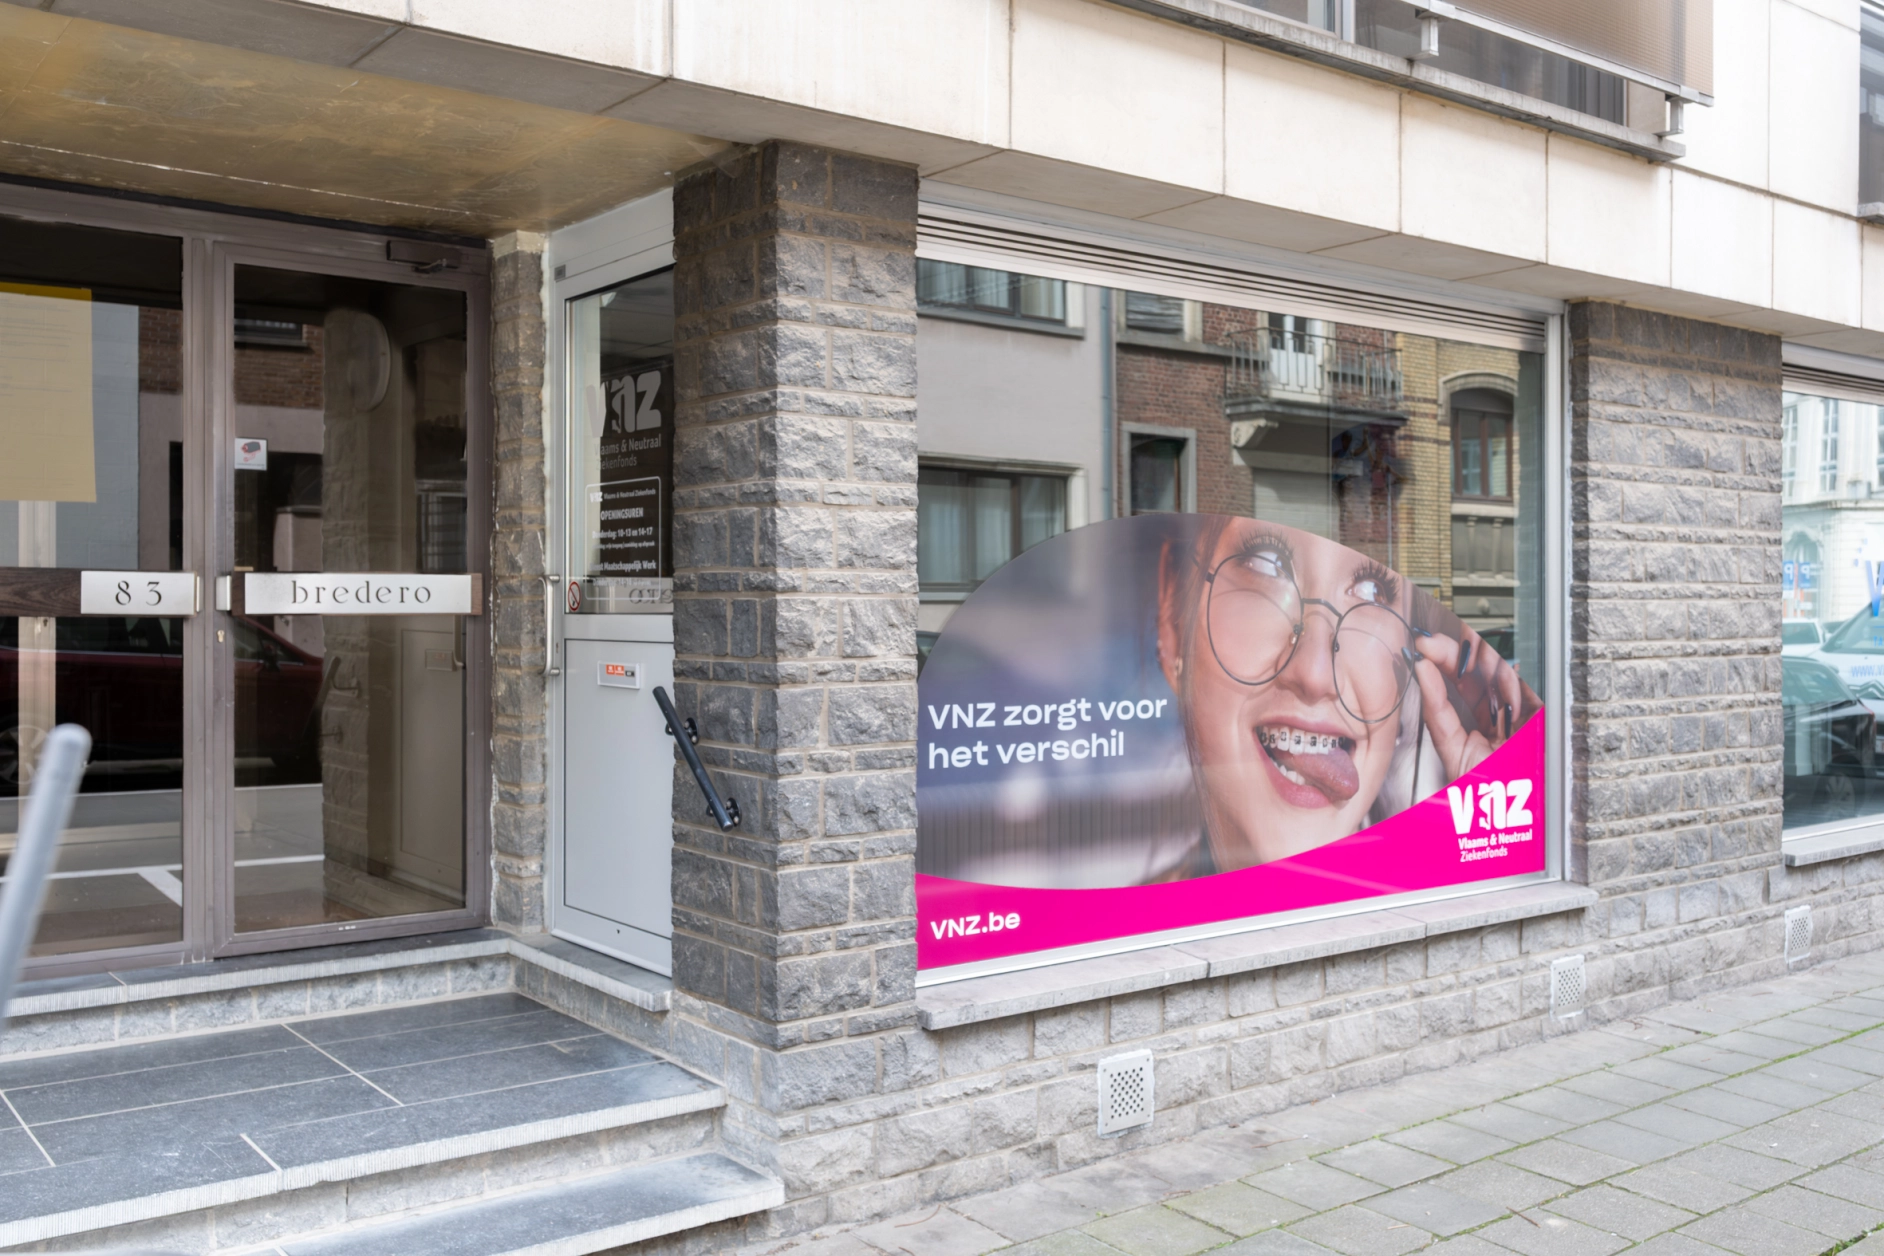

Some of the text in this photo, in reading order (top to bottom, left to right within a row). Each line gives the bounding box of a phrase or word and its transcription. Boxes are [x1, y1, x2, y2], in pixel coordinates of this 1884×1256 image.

[621, 439, 627, 452] &
[629, 433, 661, 451] Neutraal
[600, 507, 644, 521] OPENINGSUREN
[642, 559, 656, 569] Werk
[291, 580, 432, 606] bredero
[928, 699, 1168, 731] VNZ zorgt voor
[928, 730, 1125, 769] het verschil
[1458, 828, 1533, 850] Vlaams & Neutraal
[1460, 846, 1508, 863] Ziekenfonds
[930, 912, 1021, 940] VNZ.be
